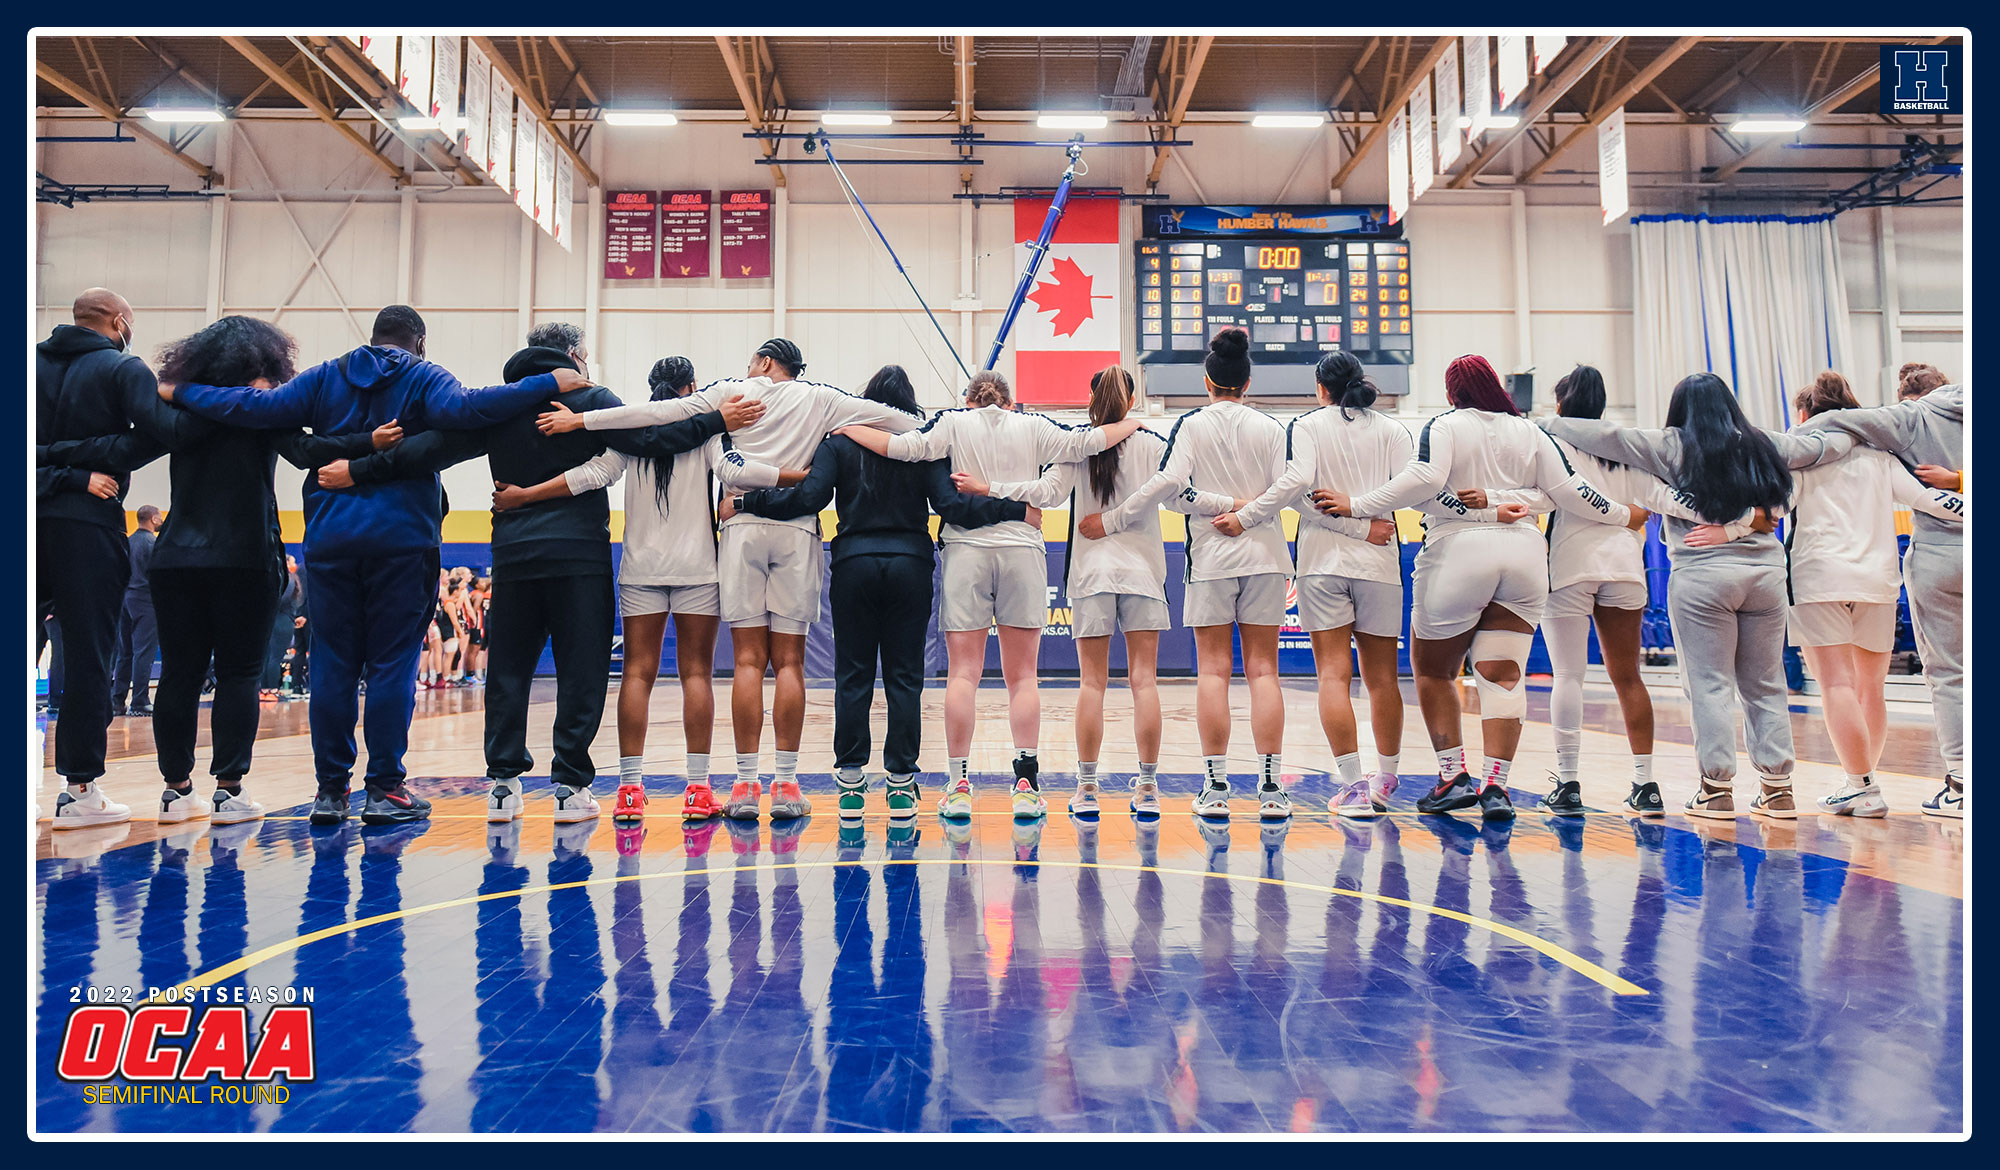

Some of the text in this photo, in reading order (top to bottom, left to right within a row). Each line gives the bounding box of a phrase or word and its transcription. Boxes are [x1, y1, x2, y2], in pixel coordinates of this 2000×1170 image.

[616, 193, 647, 203] OCAA
[671, 194, 702, 204] OCAA
[730, 193, 760, 203] OCAA
[1217, 218, 1328, 229] HUMBER HAWKS
[1151, 258, 1160, 269] 4
[1172, 258, 1180, 269] 0
[1259, 247, 1300, 270] 0:00
[1398, 258, 1408, 269] 0
[1151, 273, 1160, 285] 8
[1172, 273, 1180, 285] 0
[1192, 273, 1200, 285] 0
[1351, 273, 1408, 285] 23 0 0
[1147, 289, 1200, 301] 10 0 0
[1227, 283, 1241, 304] 0
[1323, 283, 1337, 304] 0
[1351, 289, 1409, 301] 24 0 0
[1148, 305, 1201, 317] 13 0 0
[1358, 305, 1409, 317] 4 0 0
[1148, 321, 1201, 333] 15 0 0
[1352, 321, 1410, 333] 32 0 0
[1435, 490, 1468, 515] TOPS
